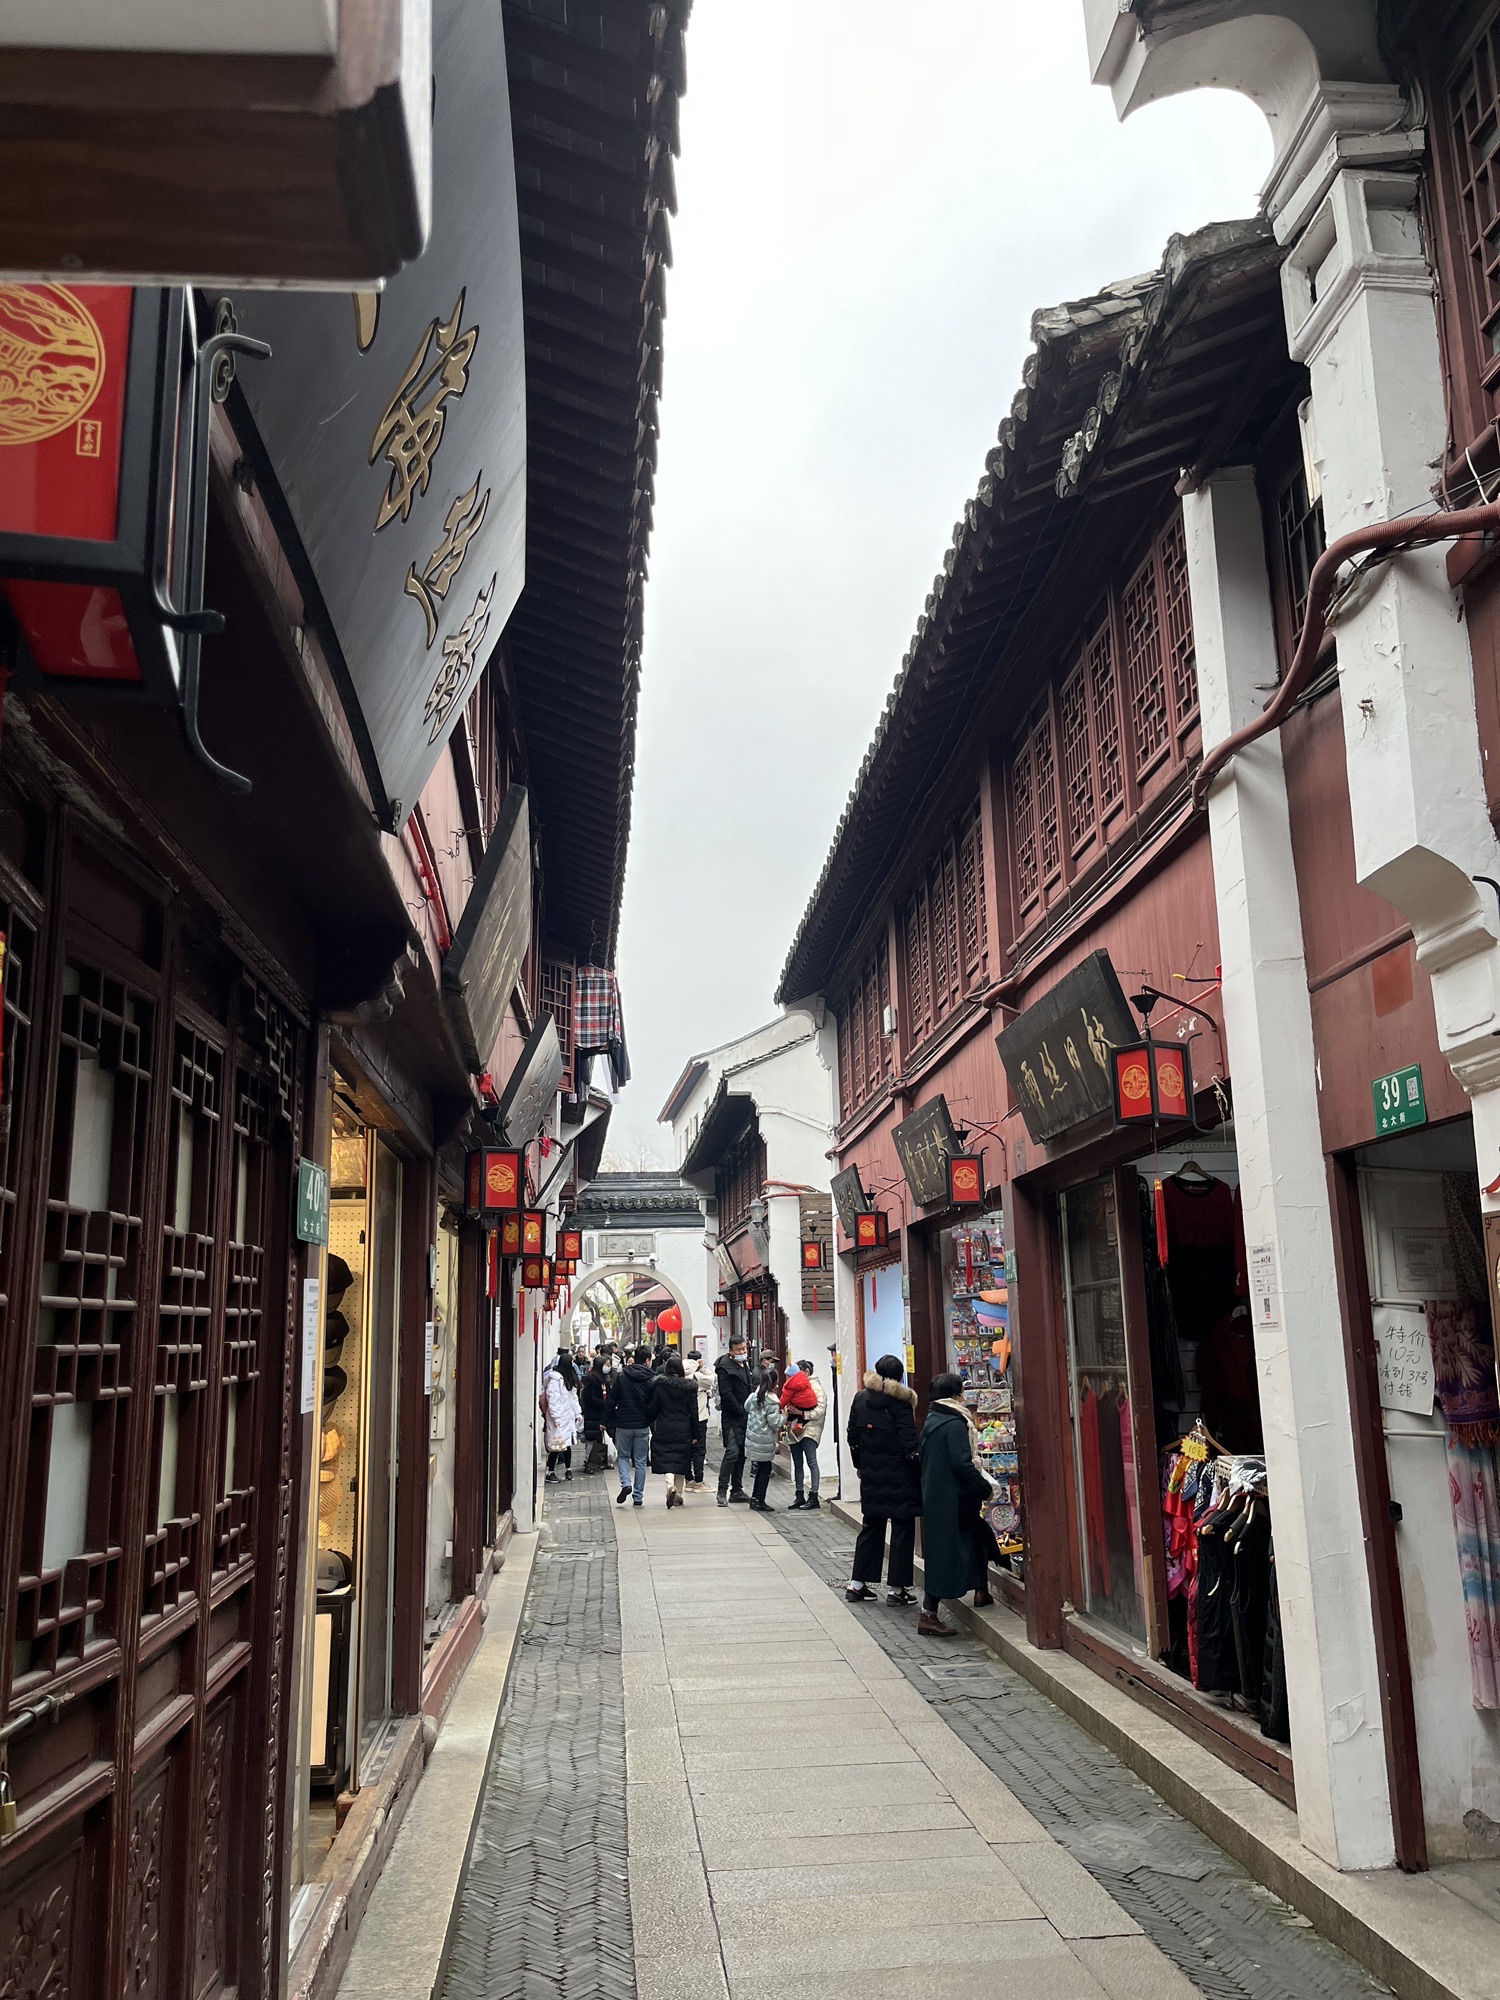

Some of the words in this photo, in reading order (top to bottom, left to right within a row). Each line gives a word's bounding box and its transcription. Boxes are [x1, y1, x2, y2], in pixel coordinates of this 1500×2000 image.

[353, 286, 497, 746] 海丝韵
[1381, 1076, 1400, 1110] 39
[1382, 1112, 1406, 1128] 北大街
[306, 1170, 321, 1212] 40
[303, 1217, 320, 1235] 北大街
[1384, 1325, 1427, 1347] 特价
[1388, 1347, 1421, 1364] 10元
[1383, 1383, 1413, 1398] 付钱
